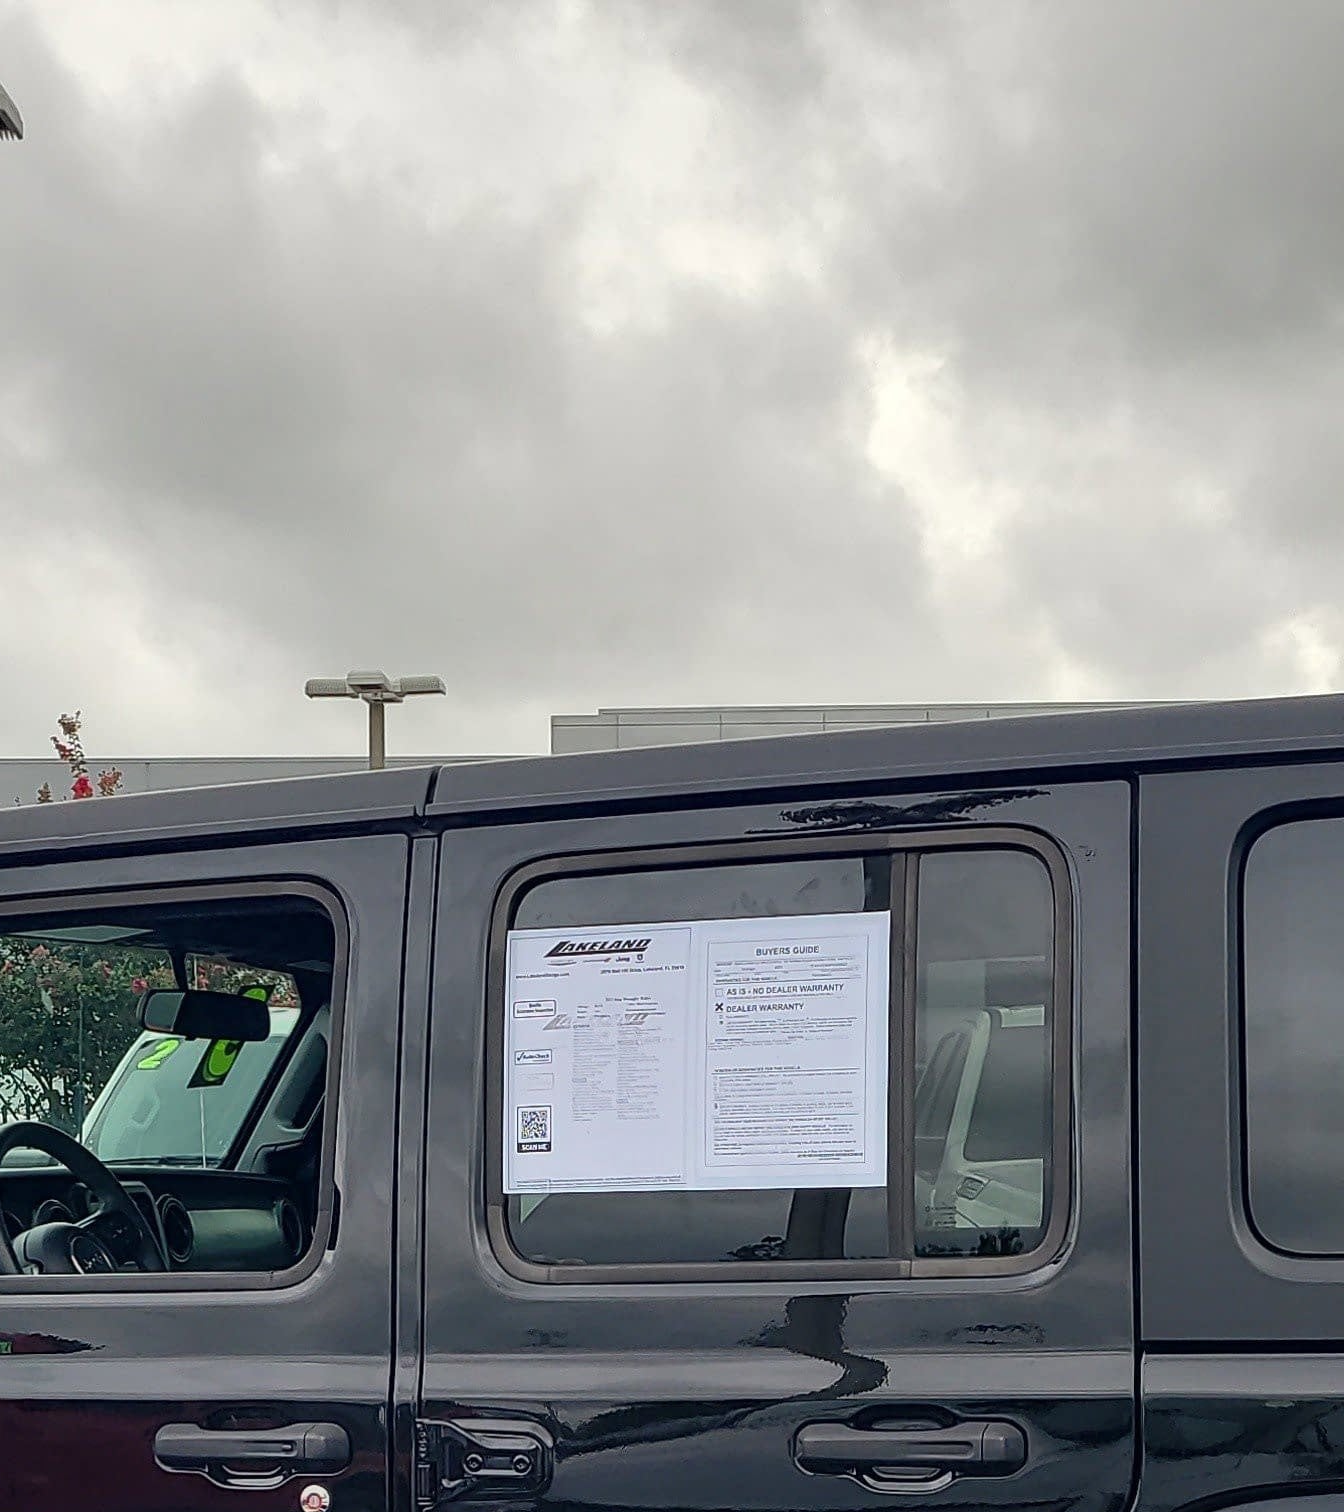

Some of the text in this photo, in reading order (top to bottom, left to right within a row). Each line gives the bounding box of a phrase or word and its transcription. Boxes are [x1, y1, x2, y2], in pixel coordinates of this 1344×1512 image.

[544, 938, 652, 958] LAKELAND
[756, 945, 819, 956] BUYERS GUIDE
[726, 988, 737, 996] AS
[739, 987, 747, 995] IS
[753, 986, 764, 995] NO
[766, 985, 797, 994] DEALER
[800, 983, 844, 992] WARRANTY
[726, 1004, 757, 1013] DEALER
[760, 1003, 804, 1012] WARRANTY
[137, 1038, 180, 1070] 2
